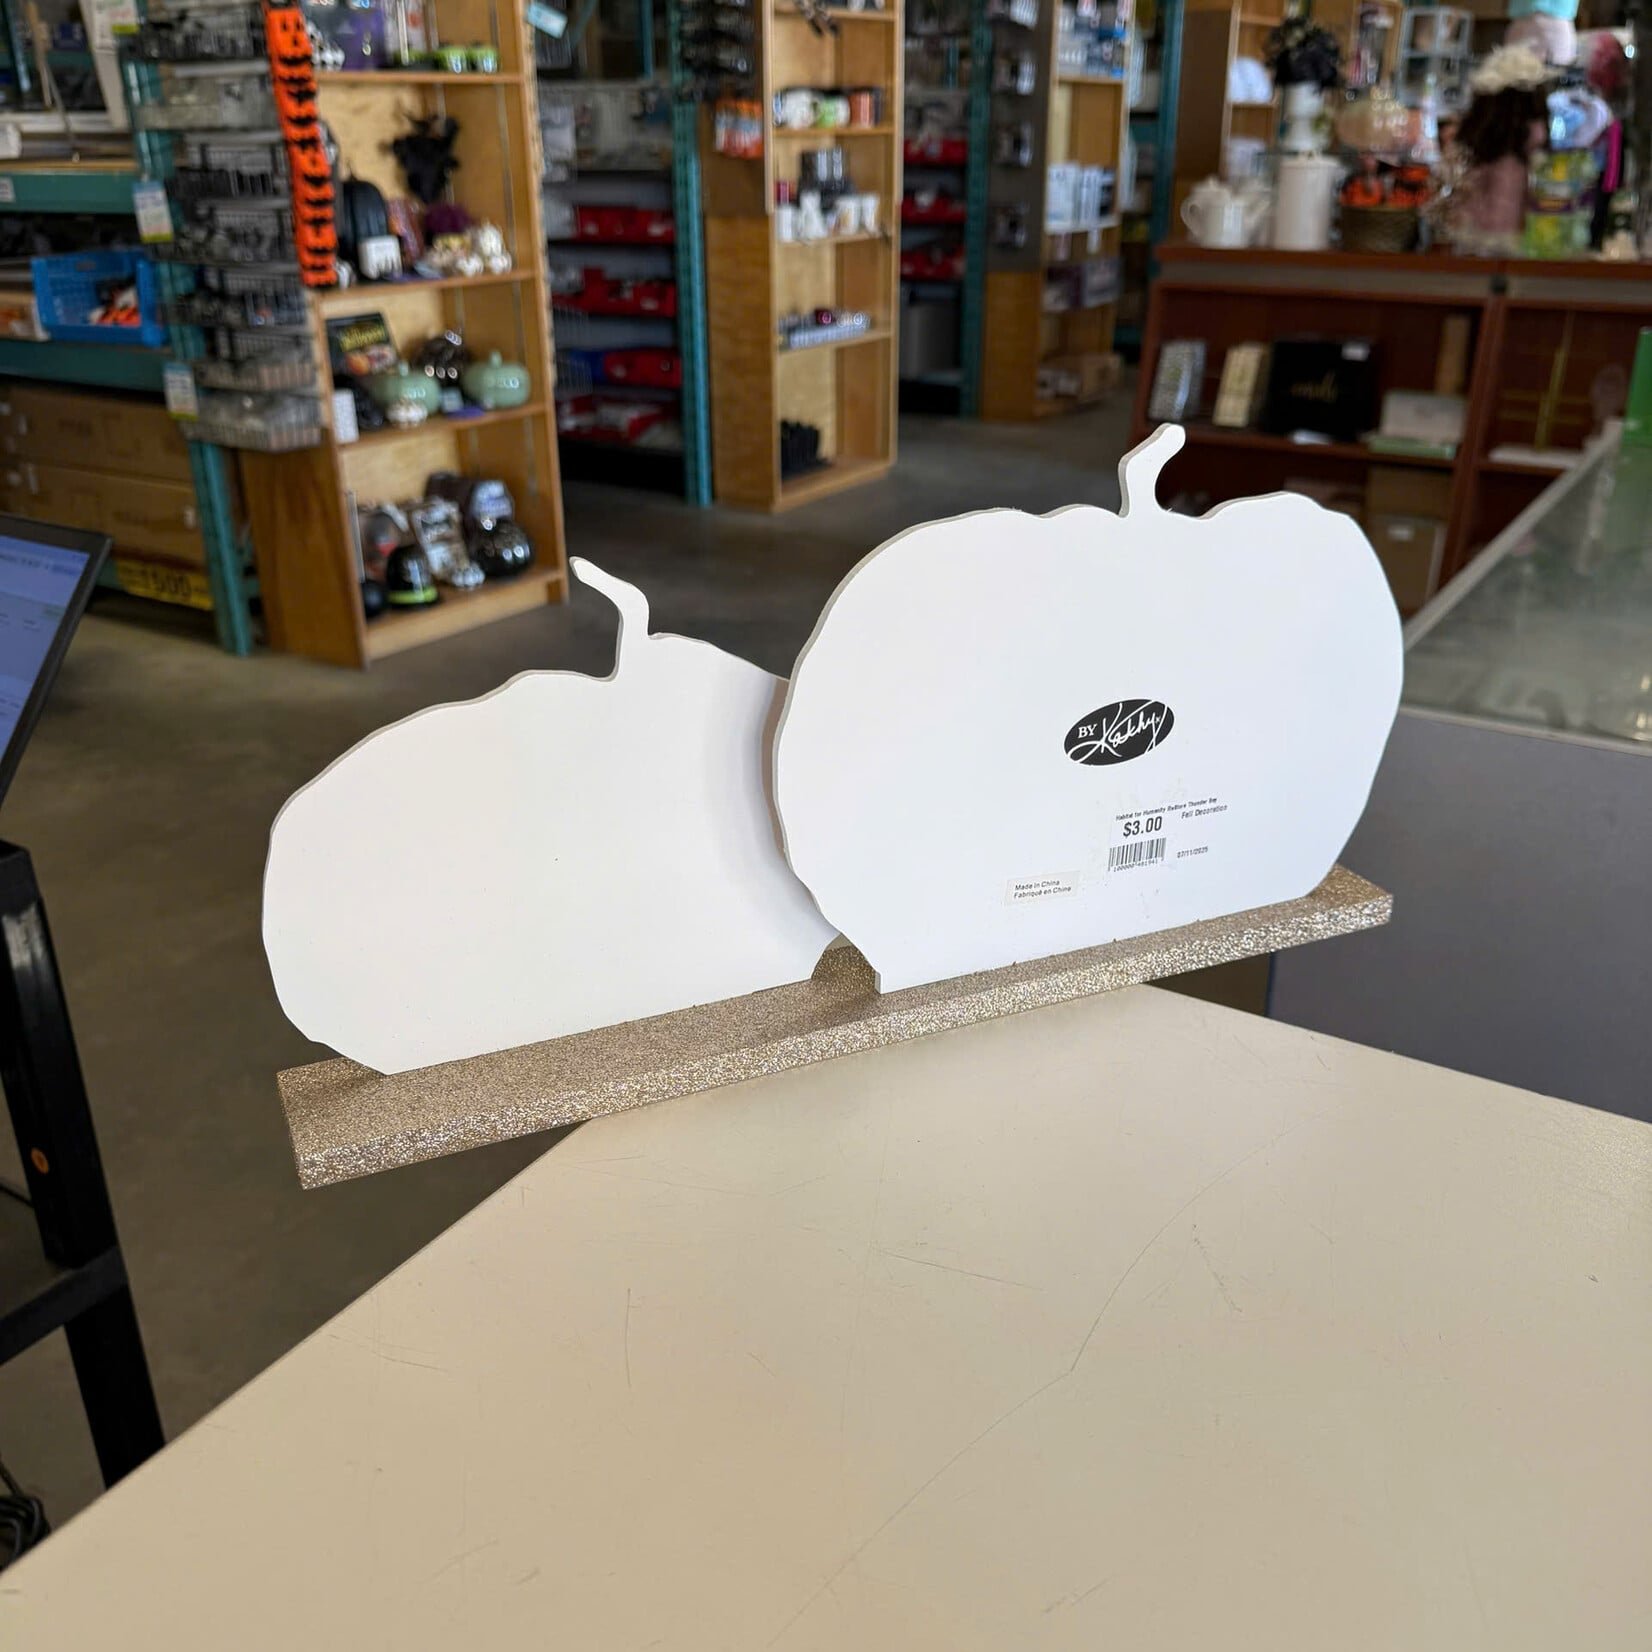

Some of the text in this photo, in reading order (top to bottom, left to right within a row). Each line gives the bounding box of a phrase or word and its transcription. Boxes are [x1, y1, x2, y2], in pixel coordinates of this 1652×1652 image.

[1068, 700, 1167, 761] BY Kathy
[1115, 813, 1134, 821] Habitat
[1143, 806, 1166, 817] Humanity
[1188, 798, 1208, 807] Thunder
[1208, 797, 1218, 805] Bay
[1194, 804, 1228, 817] Decoration
[1122, 816, 1163, 839] $3.00
[1015, 883, 1033, 891] Made
[1041, 880, 1060, 888] China
